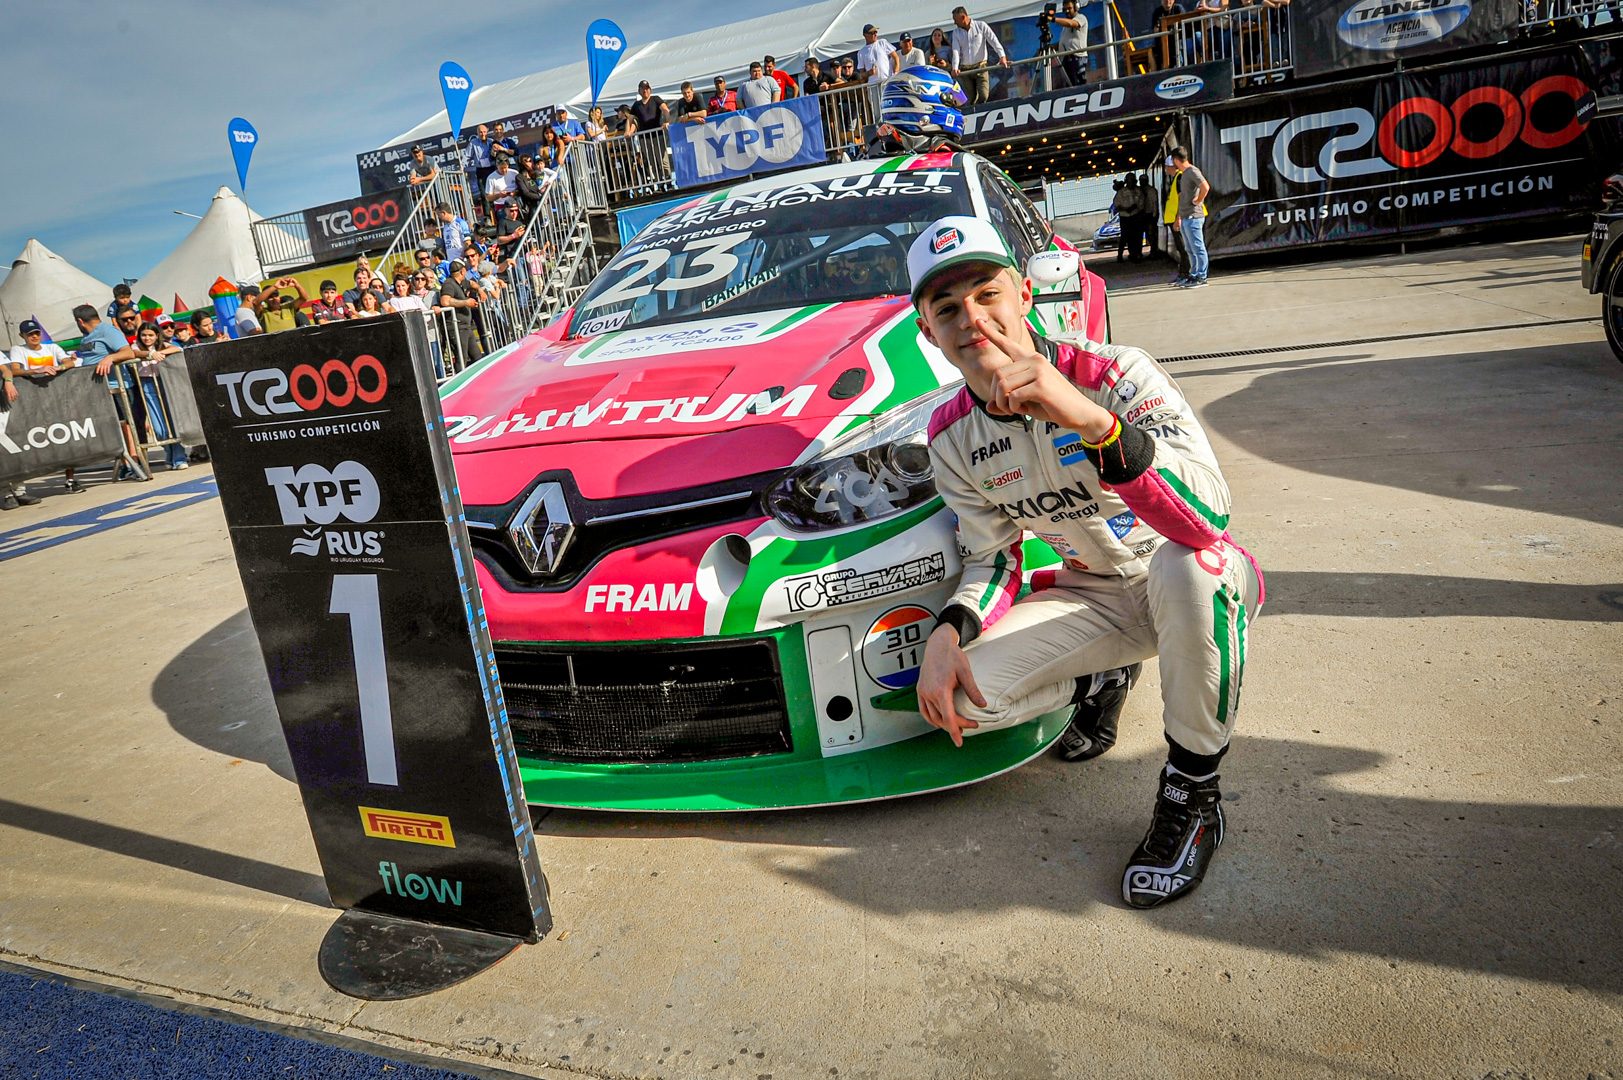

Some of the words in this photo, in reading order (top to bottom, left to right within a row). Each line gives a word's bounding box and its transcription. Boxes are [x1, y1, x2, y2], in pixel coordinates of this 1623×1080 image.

[1386, 19, 1421, 34] AGENCIA
[1162, 78, 1197, 88] TANGO
[963, 86, 1125, 135] TANGO
[705, 122, 784, 158] YPF
[1220, 75, 1591, 190] TC2000
[635, 185, 953, 242] CONCESIONARIOS
[642, 172, 960, 233] RENAULT
[1263, 199, 1368, 226] TURISMO
[1378, 174, 1554, 210] COMPETICIÓN
[316, 200, 399, 237] TC2000
[641, 219, 767, 251] MONTENEGRO
[585, 231, 752, 310] 23
[704, 265, 781, 309] BARPRAN
[579, 315, 626, 336] flow
[615, 328, 713, 347] AXION
[597, 344, 657, 358] SPORT
[671, 334, 744, 347] TC2000
[215, 354, 388, 418] TC2000
[1126, 396, 1166, 423] Castrol
[247, 429, 296, 442] TURISMO
[300, 419, 381, 437] COMPETICIÓN
[971, 436, 1012, 466] FRAM
[284, 479, 361, 507] YPF
[1050, 502, 1100, 523] energy
[325, 530, 382, 556] RUS
[823, 570, 856, 581] GRUPO
[825, 552, 944, 598] GERVASINI
[919, 569, 945, 585] Racing
[584, 582, 693, 613] FRAM
[845, 582, 901, 601] NEUMATICOS
[885, 623, 921, 649] 30
[896, 647, 919, 670] 11
[329, 574, 399, 787] 1
[1164, 786, 1188, 801] OMP
[367, 813, 445, 840] PIRELLI
[378, 861, 462, 906] flow
[1133, 872, 1185, 893] OMP
